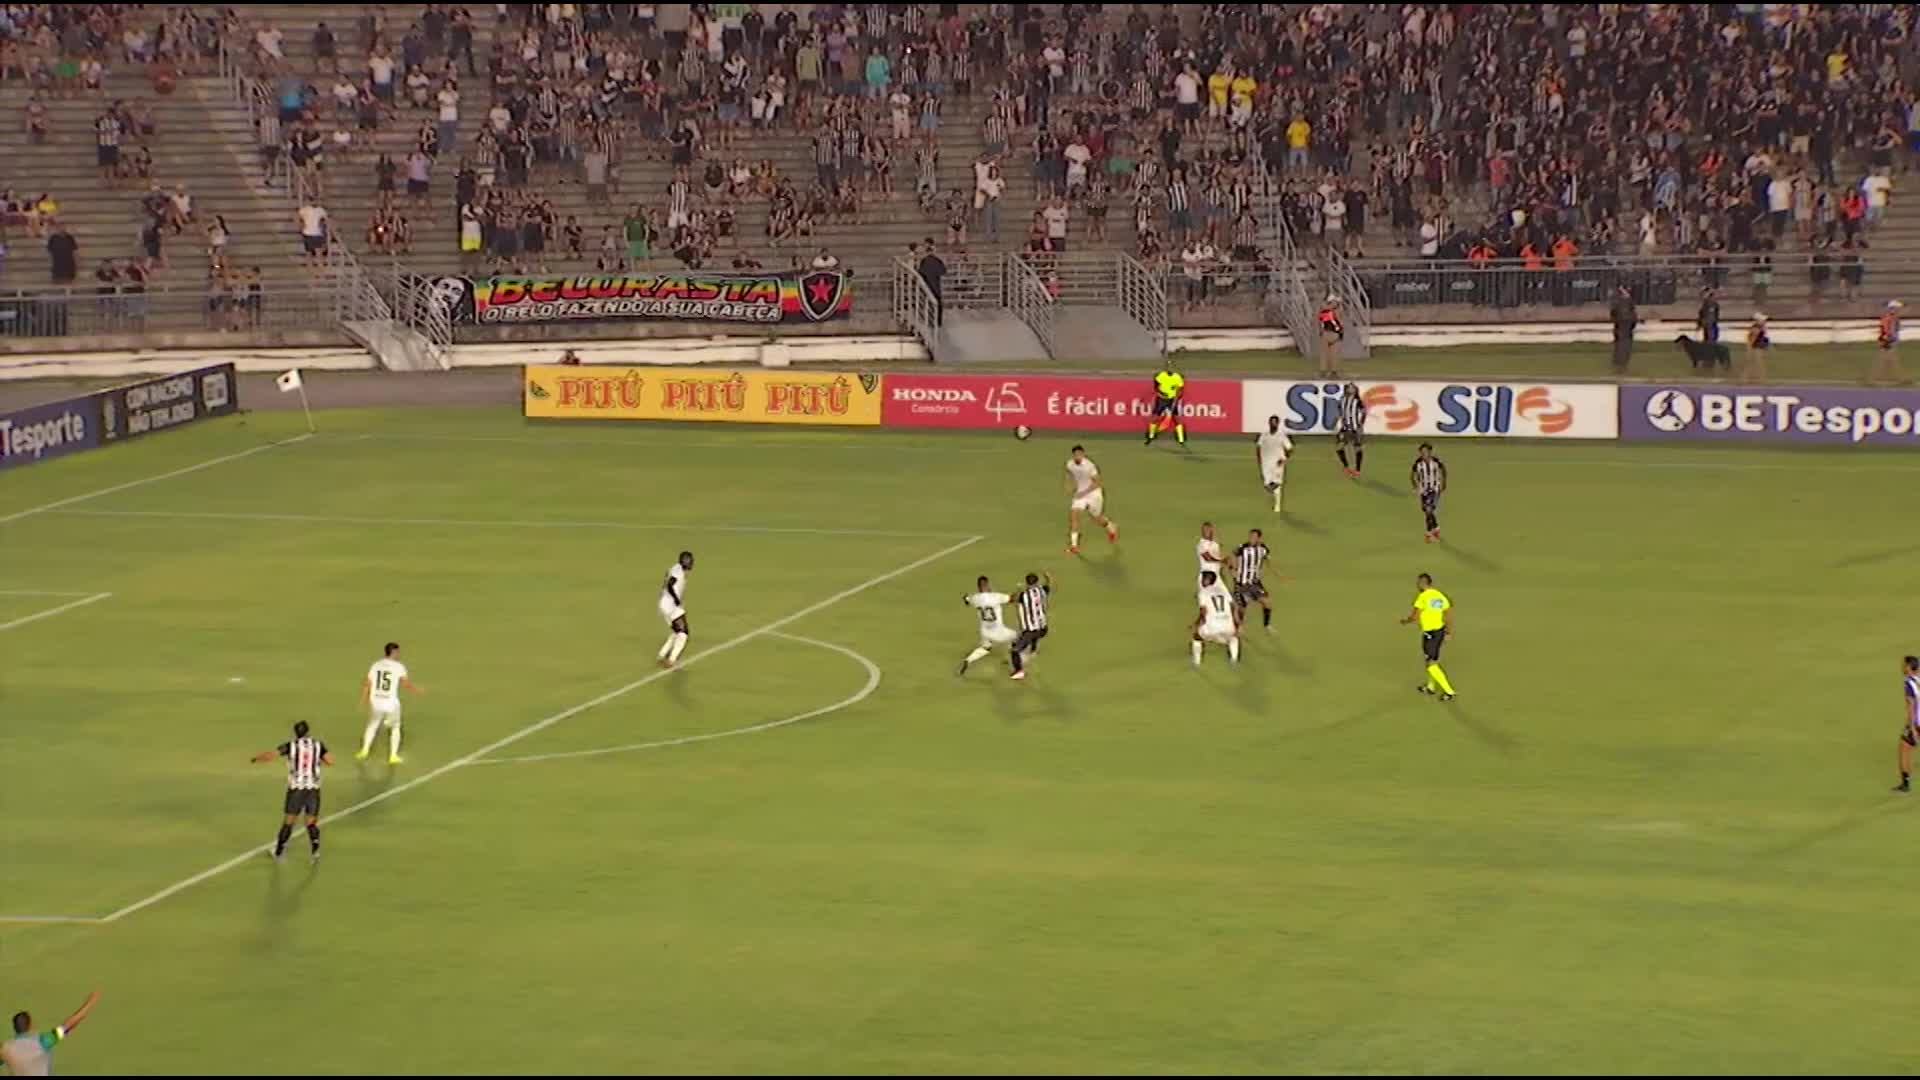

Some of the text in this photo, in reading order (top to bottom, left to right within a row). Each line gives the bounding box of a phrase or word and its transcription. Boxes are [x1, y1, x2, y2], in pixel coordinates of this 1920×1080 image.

[558, 300, 647, 316] FAZENDO
[669, 301, 700, 316] SUA
[892, 387, 977, 401] HONDA
[1047, 393, 1060, 414] É
[1065, 394, 1110, 415] fácil
[1115, 400, 1127, 416] e
[1436, 385, 1513, 433] Sil
[1211, 595, 1225, 612] 17
[376, 670, 392, 691] 15
